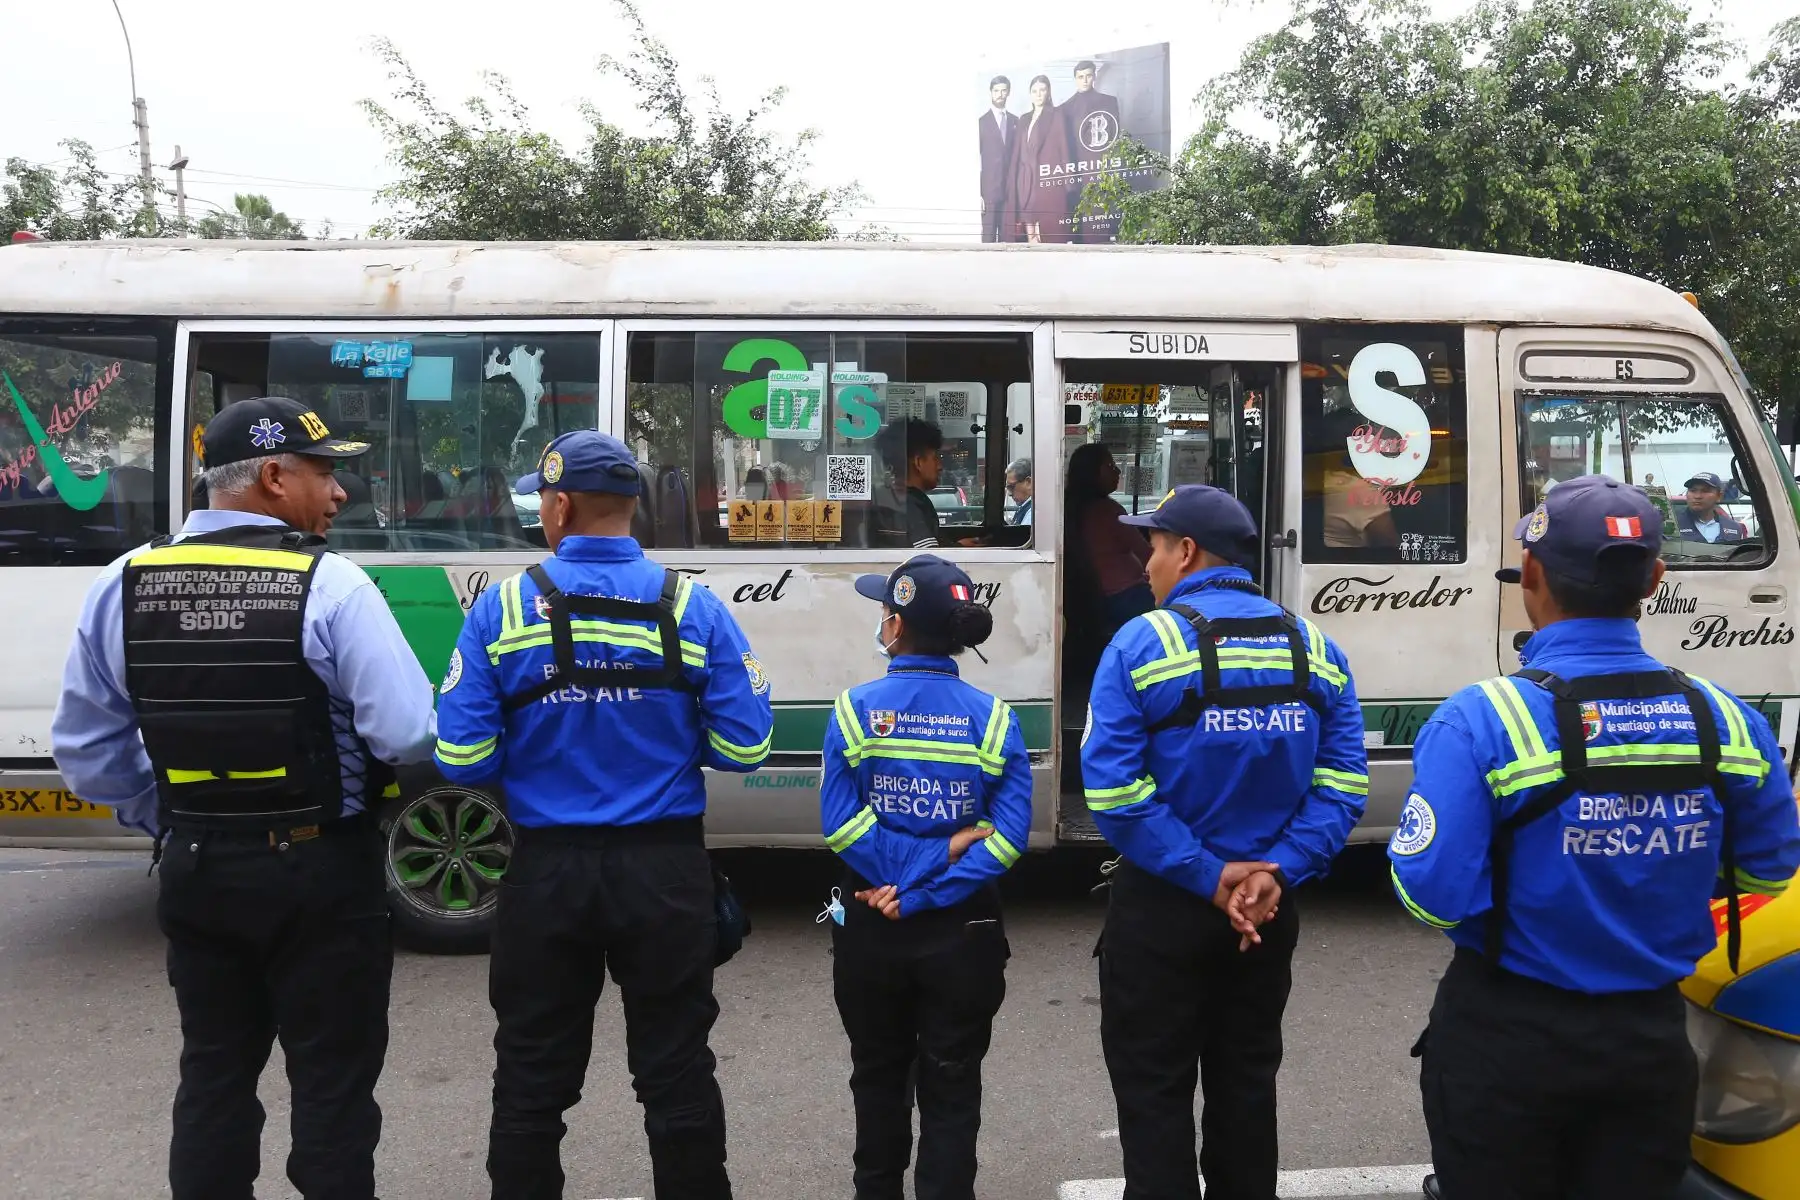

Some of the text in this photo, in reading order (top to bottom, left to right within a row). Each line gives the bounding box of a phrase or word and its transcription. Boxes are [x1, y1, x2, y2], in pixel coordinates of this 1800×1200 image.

[1089, 114, 1109, 147] B
[335, 343, 409, 362] La Kalle
[1129, 335, 1209, 354] SUBIDA
[770, 373, 804, 381] HOLDING
[833, 373, 869, 382] HOLDING
[1616, 360, 1633, 379] ES
[41, 361, 122, 447] Antonio
[0, 444, 36, 491] rgio
[139, 570, 300, 584] MUNICIPALIDAD DE
[134, 582, 304, 597] SANTIAGO DE SURCO
[1311, 575, 1473, 615] Corredor
[1647, 581, 1698, 616] Palma
[134, 599, 300, 613] JEFE DE OPERACIONES
[179, 611, 246, 632] SGDC
[1681, 615, 1795, 651] Perchis
[897, 712, 970, 726] Municipalidad
[1205, 709, 1306, 732] RESCATE
[1606, 721, 1616, 732] de
[1616, 719, 1656, 733] santiago
[1659, 718, 1672, 729] de
[897, 725, 968, 737] de santiago de surco
[743, 775, 817, 788] HOLDING
[873, 774, 970, 796] BRIGADA DE
[868, 792, 975, 820] RESCATE
[1579, 793, 1705, 820] BRIGADA DE
[1563, 820, 1711, 857] RESCATE
